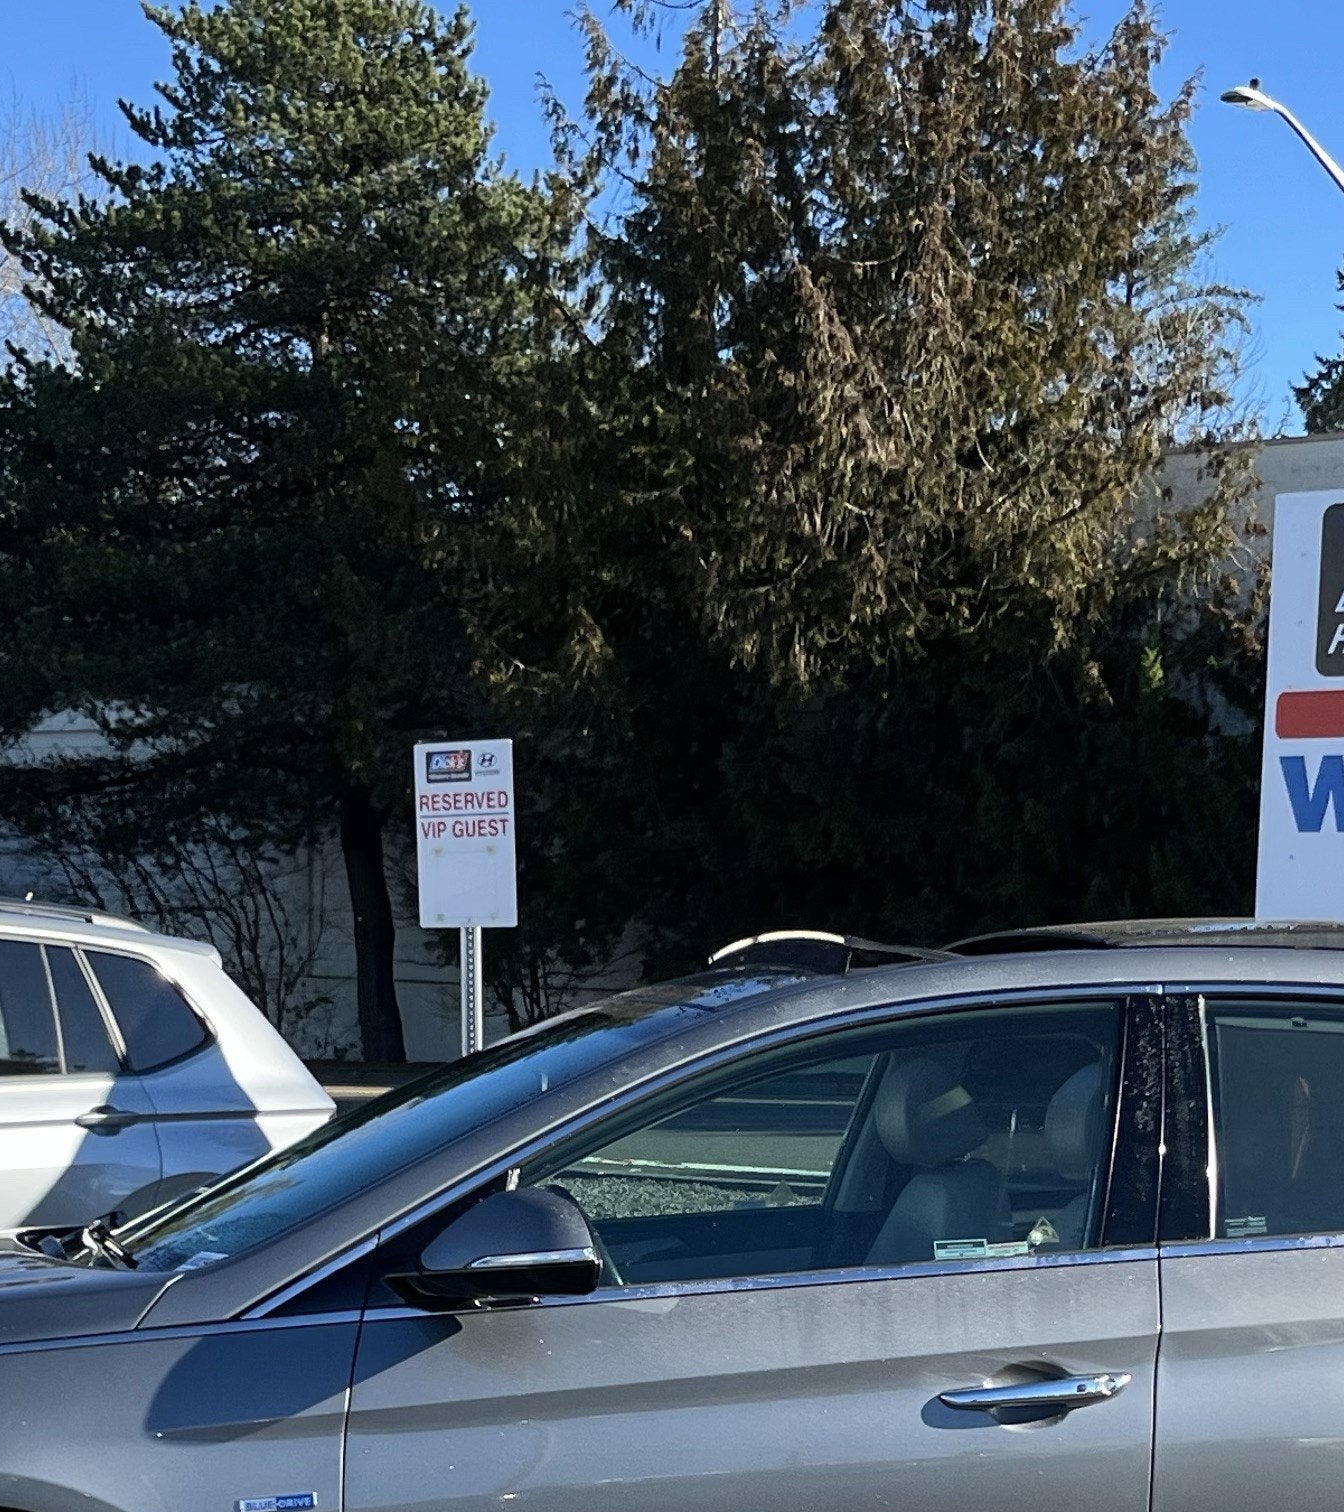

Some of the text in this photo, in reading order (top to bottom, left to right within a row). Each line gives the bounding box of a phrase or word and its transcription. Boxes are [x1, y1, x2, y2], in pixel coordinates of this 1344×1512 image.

[419, 791, 509, 813] RESERVED
[421, 819, 509, 840] VIP GUEST
